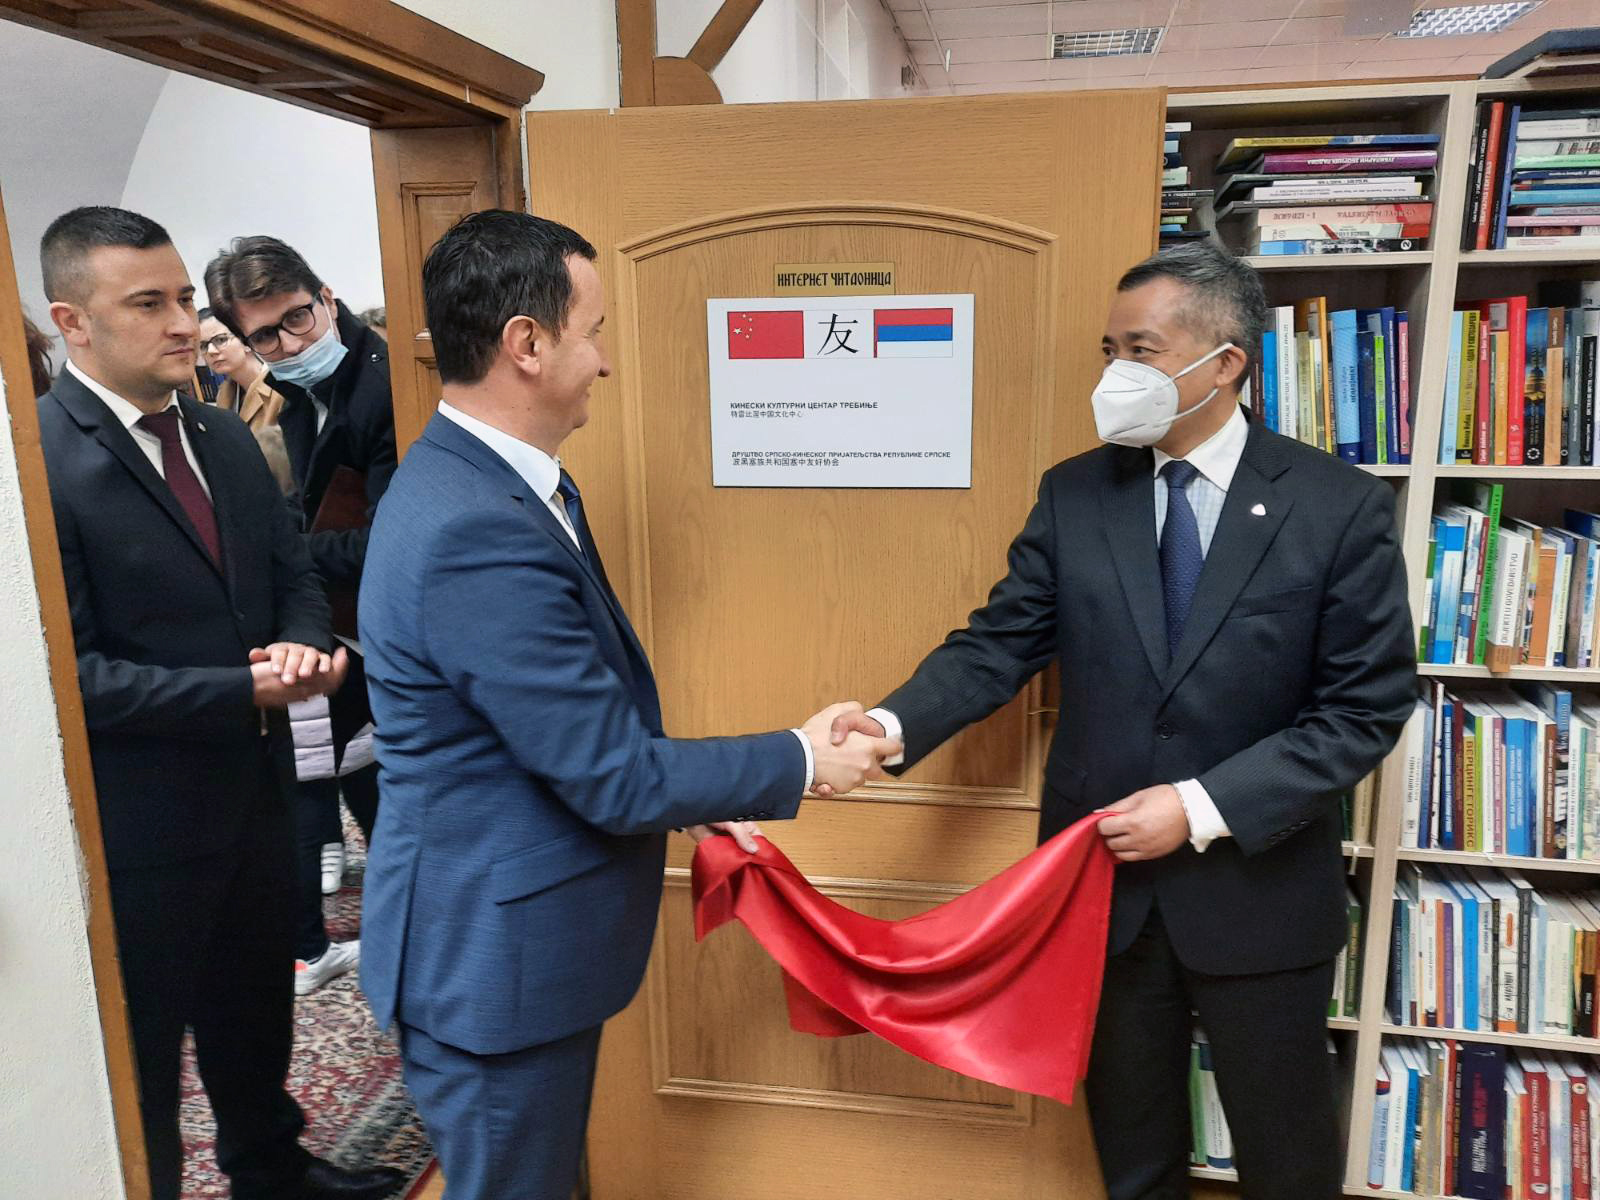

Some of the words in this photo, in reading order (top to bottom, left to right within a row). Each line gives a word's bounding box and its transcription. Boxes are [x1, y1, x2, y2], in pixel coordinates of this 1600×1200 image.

[777, 272, 828, 287] ИНТЕРНЕТ
[831, 271, 891, 287] ЧИТАОНИЦА
[817, 313, 859, 356] 友
[808, 402, 838, 410] ЦЕНТАР
[1466, 741, 1475, 848] ВЕРЦИНГЕТОРИКС
